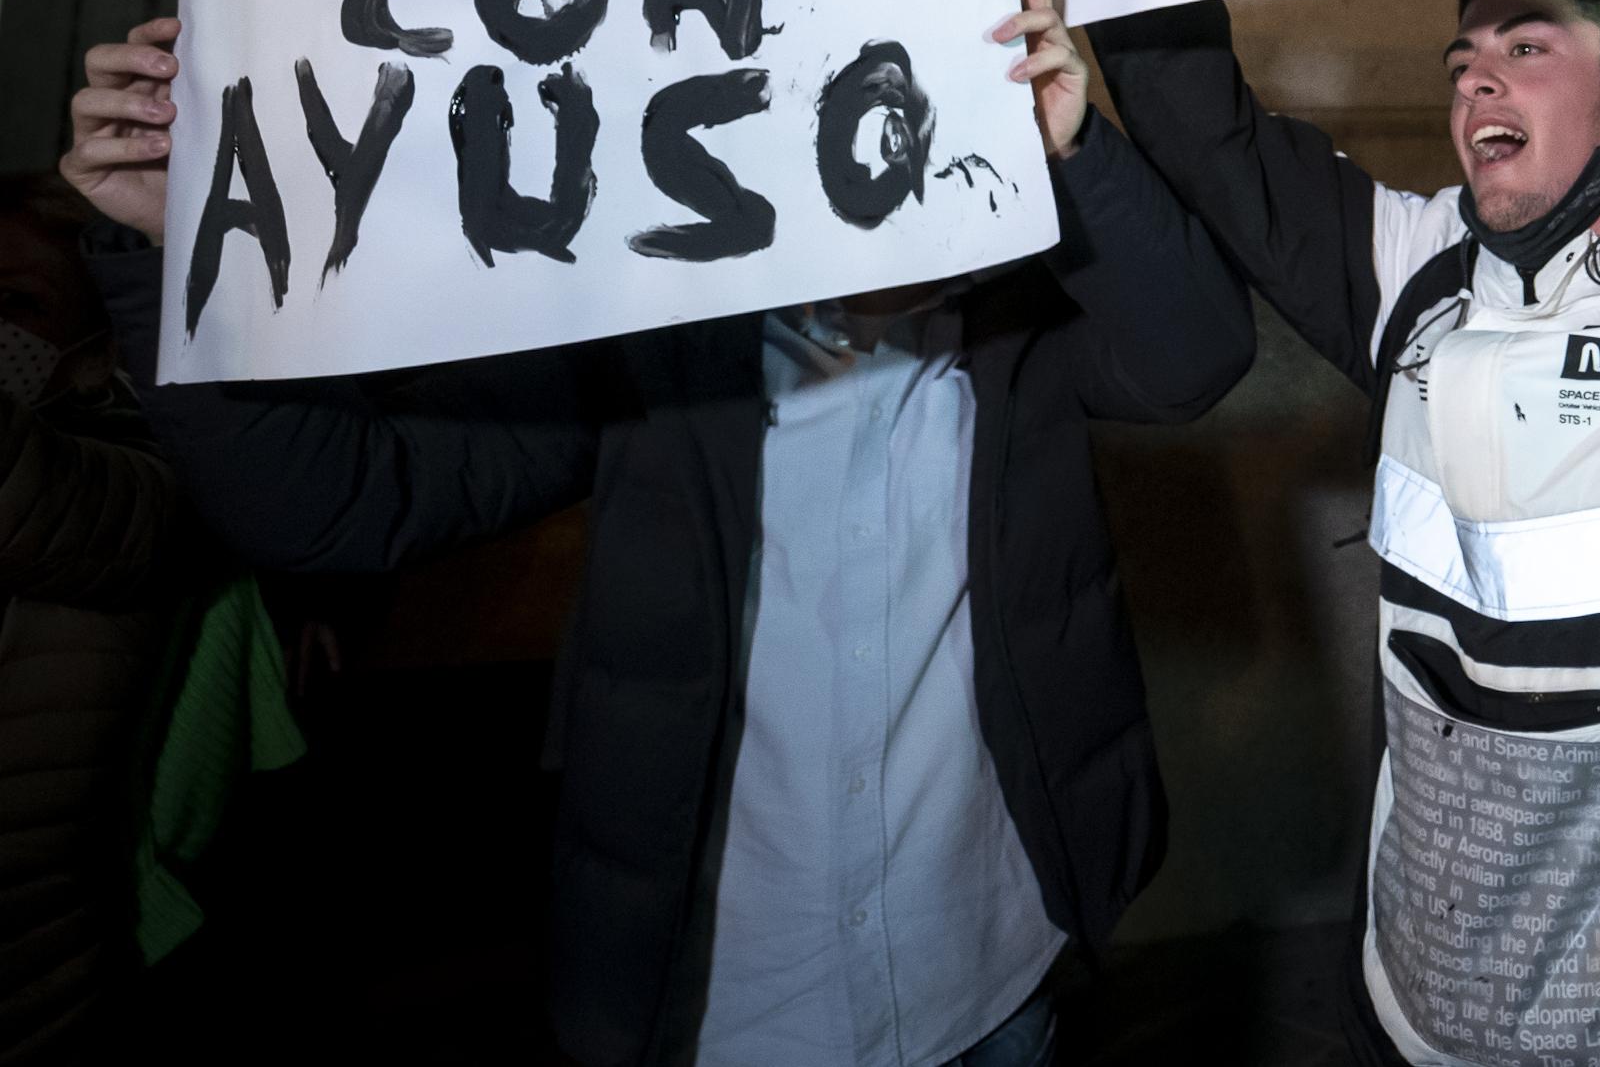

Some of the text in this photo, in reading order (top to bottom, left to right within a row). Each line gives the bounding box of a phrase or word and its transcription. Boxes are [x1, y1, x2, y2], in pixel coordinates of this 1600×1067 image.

[186, 38, 938, 345] AYUSO
[1558, 389, 1600, 401] SPACE
[1558, 413, 1581, 426] STS
[1461, 731, 1489, 752] and
[1495, 737, 1548, 762] Space
[1523, 784, 1581, 802] civilian
[1438, 790, 1465, 810] and
[1470, 799, 1555, 825] aerospace
[1448, 812, 1463, 830] in
[1433, 828, 1453, 850] for
[1451, 859, 1504, 888] civilian
[1450, 880, 1463, 901] in
[1478, 891, 1530, 911] space
[1501, 933, 1526, 954] the
[1429, 947, 1473, 972] space
[1546, 954, 1578, 975] and
[1505, 983, 1531, 1003] the
[1462, 1001, 1489, 1022] the
[1485, 1029, 1512, 1051] the
[1519, 1030, 1577, 1052] Space
